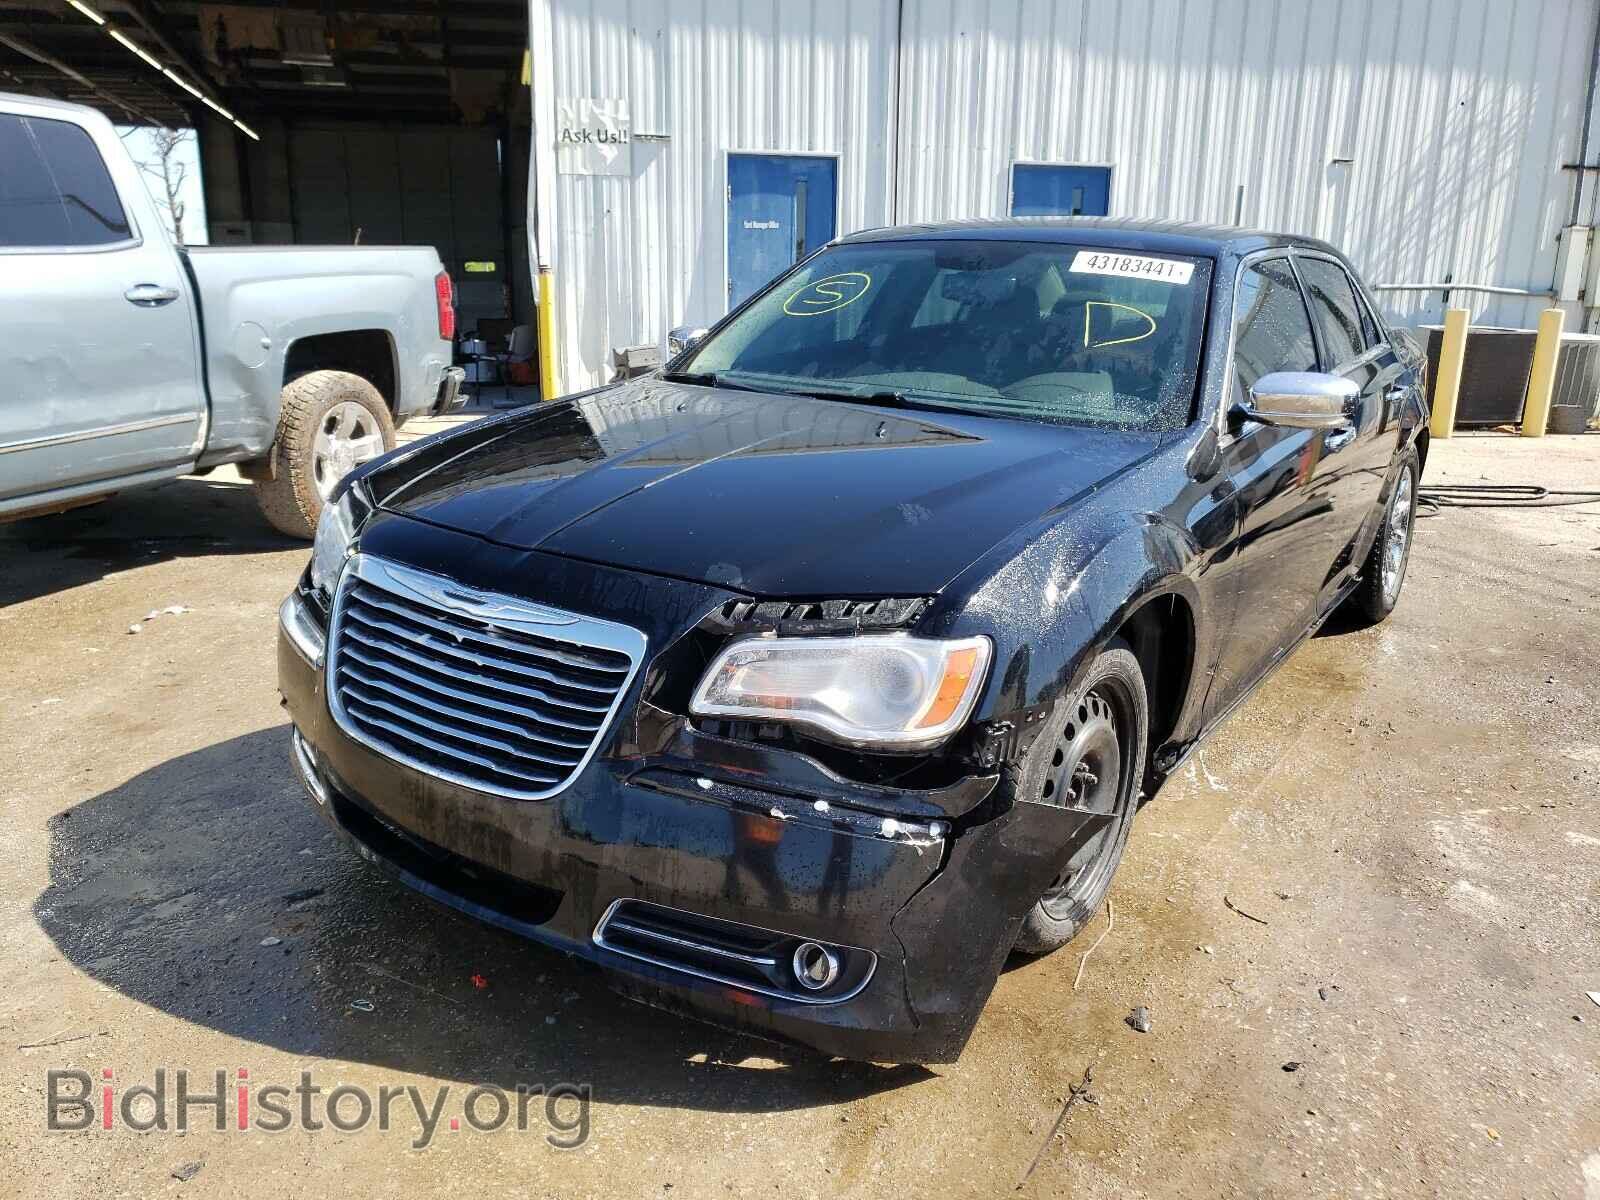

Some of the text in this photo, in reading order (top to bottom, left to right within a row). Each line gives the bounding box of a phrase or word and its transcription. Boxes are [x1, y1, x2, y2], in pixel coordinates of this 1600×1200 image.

[561, 128, 628, 144] Ask Us!!
[802, 281, 857, 304] S
[1083, 301, 1156, 348] D
